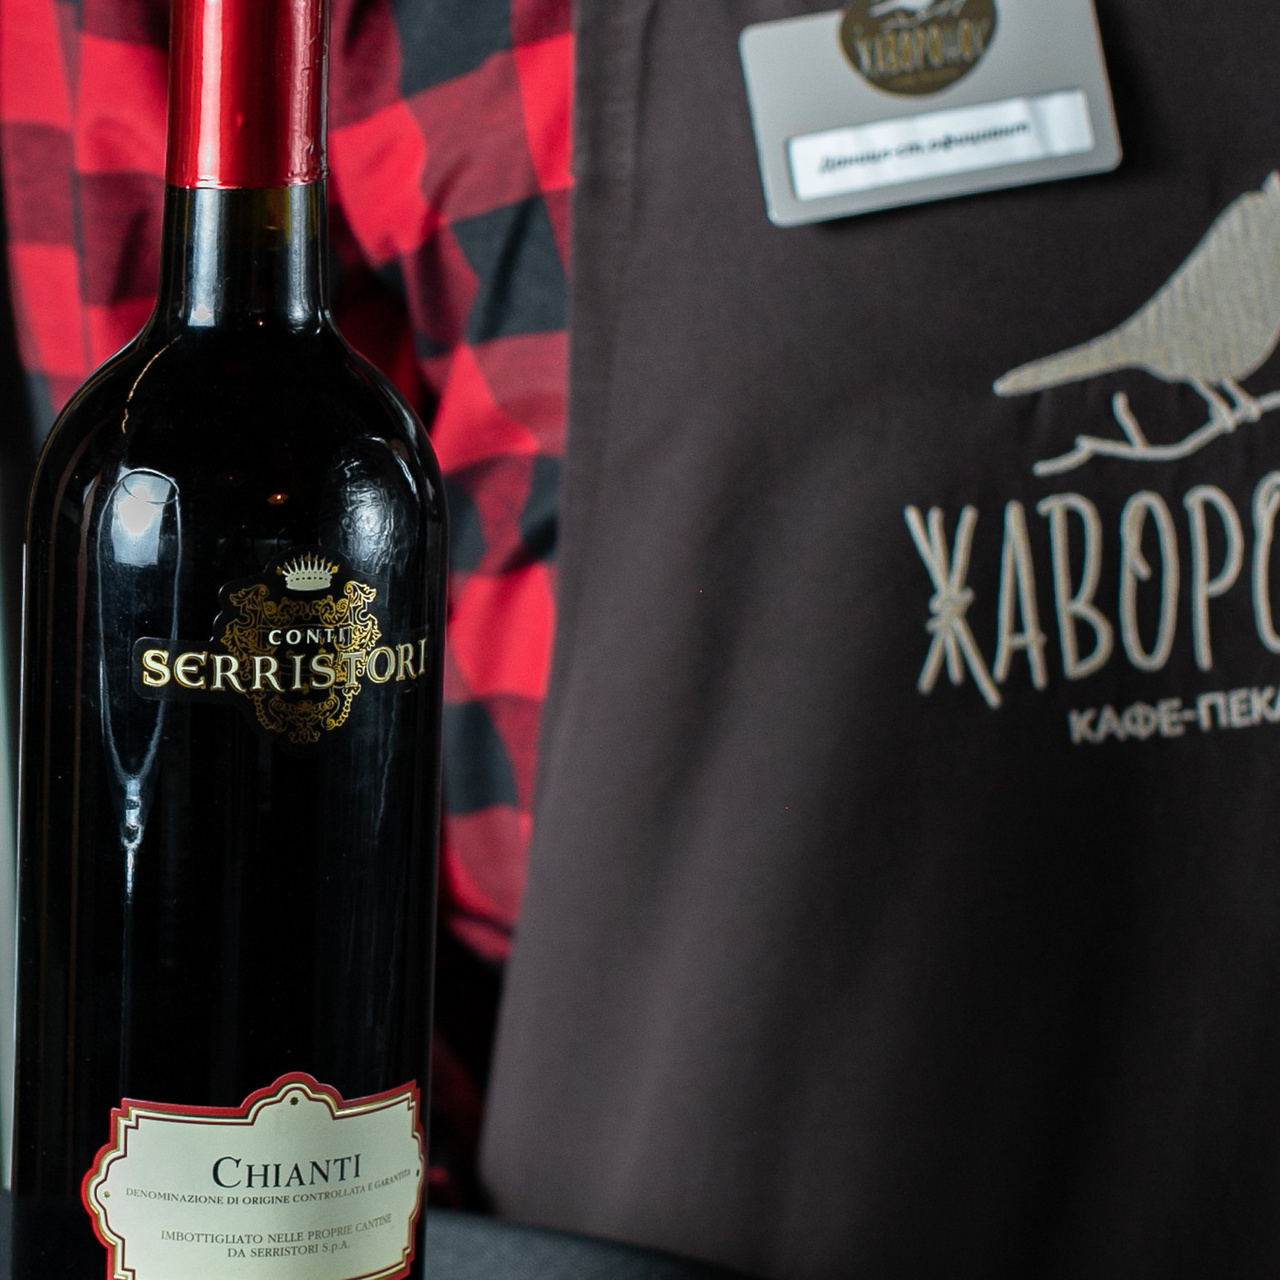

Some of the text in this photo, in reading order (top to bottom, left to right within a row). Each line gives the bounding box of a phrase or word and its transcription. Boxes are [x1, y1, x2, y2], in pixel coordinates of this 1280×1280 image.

[268, 627, 346, 646] CONTI
[141, 637, 428, 694] SERRISTORI
[211, 1153, 361, 1189] CHIANTI
[125, 1187, 224, 1205] DENOMINAZIONE
[227, 1195, 239, 1205] DI
[242, 1194, 290, 1205] ORIGINE
[292, 1185, 365, 1203] CONTROLLATA
[161, 1213, 393, 1245] IMBOTTIGLIATO NELLE PROPRIE CANTINE
[227, 1246, 246, 1258] DA
[250, 1242, 319, 1258] SERRISTORI
